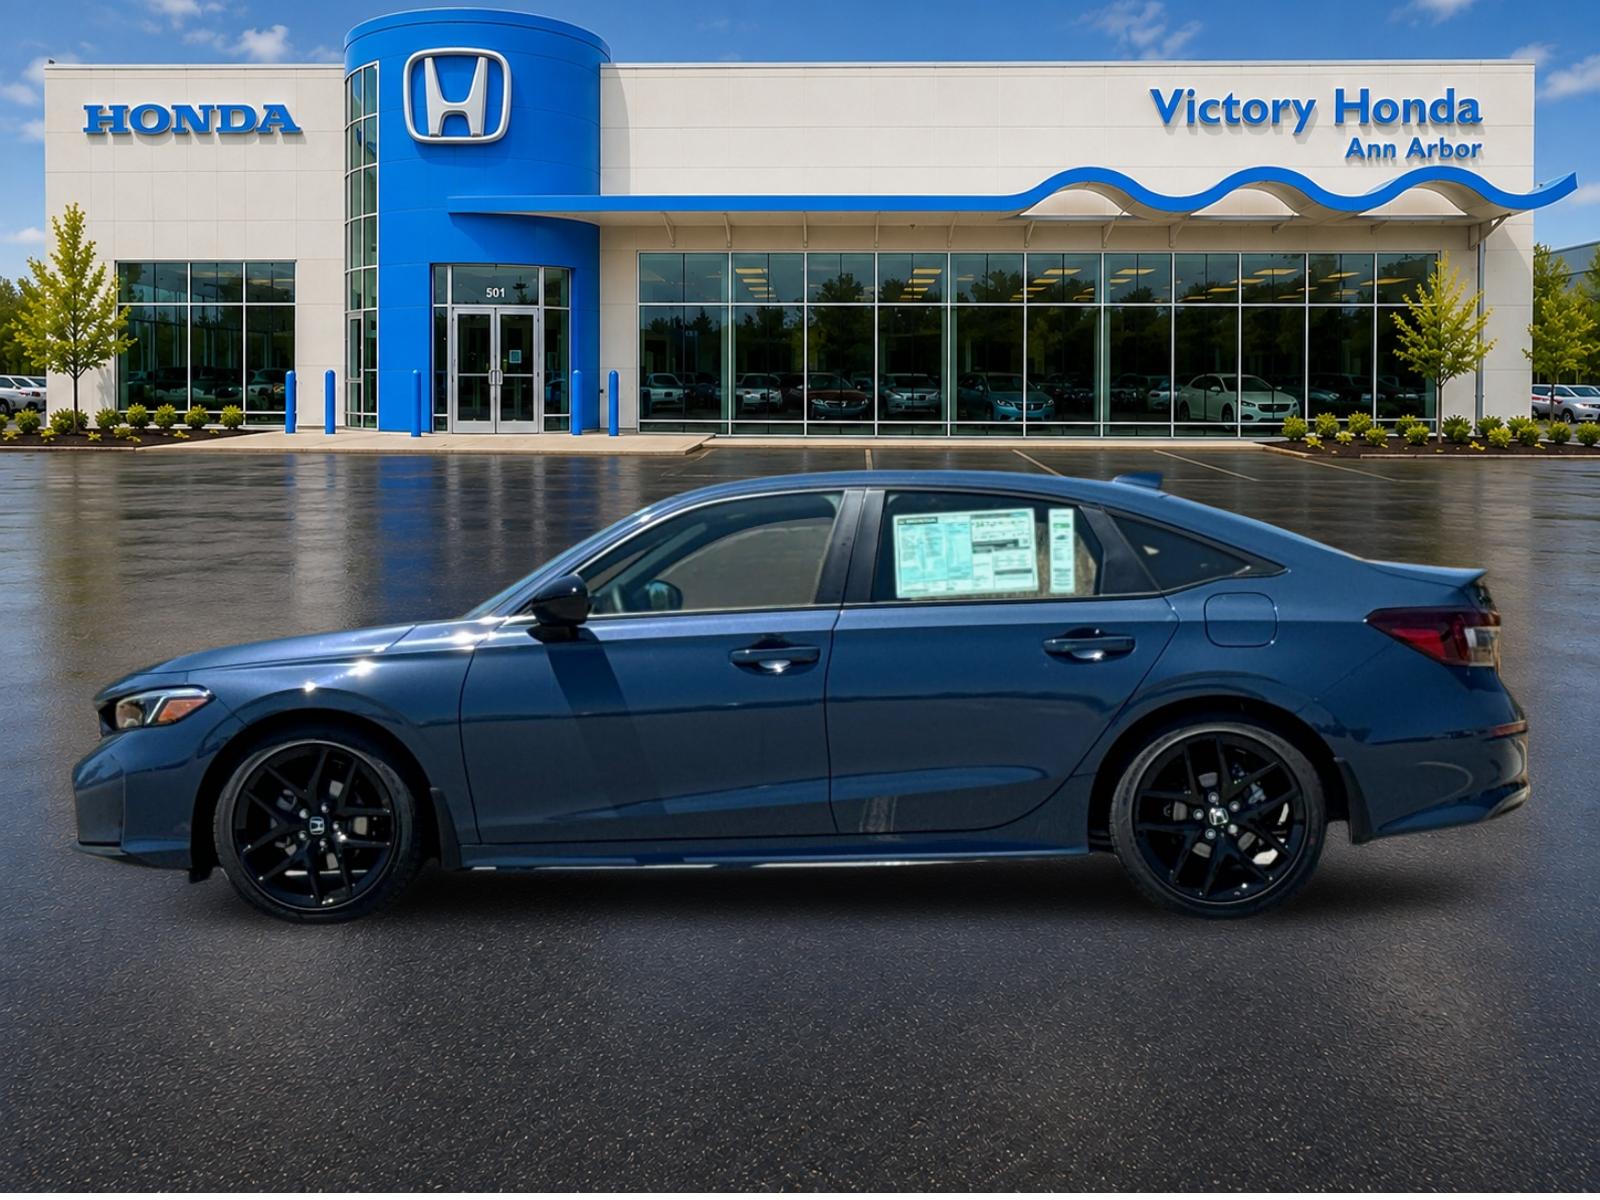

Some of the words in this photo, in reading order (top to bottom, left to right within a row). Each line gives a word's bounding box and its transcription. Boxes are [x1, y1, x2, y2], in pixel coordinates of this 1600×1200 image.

[83, 103, 302, 136] HONDA
[1150, 88, 1316, 135] Victory
[1335, 88, 1483, 126] Honda
[1345, 137, 1397, 159] Ann
[1406, 137, 1482, 159] Arbor
[486, 287, 505, 298] 501
